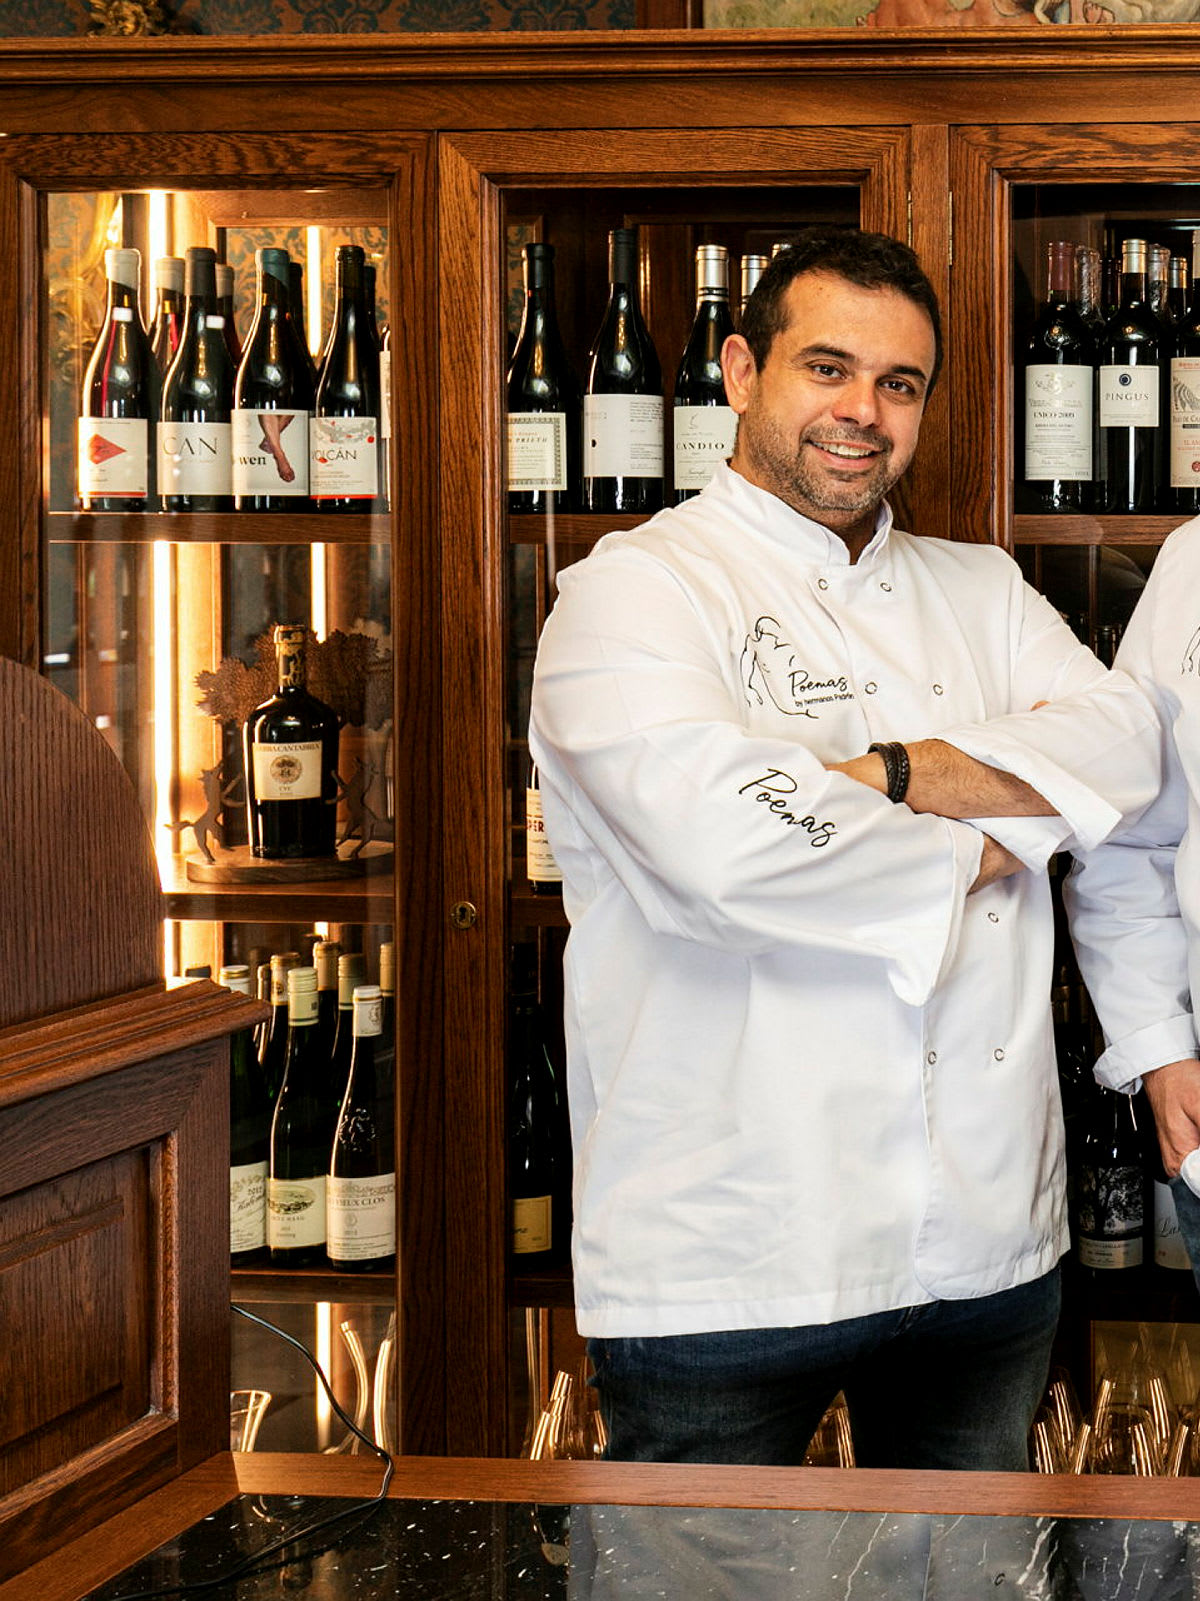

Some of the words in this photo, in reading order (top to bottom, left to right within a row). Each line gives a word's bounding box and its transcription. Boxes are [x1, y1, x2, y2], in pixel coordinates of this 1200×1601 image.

[1105, 392, 1152, 401] PINGUS
[788, 669, 849, 698] Poemas
[738, 768, 838, 848] Poemas
